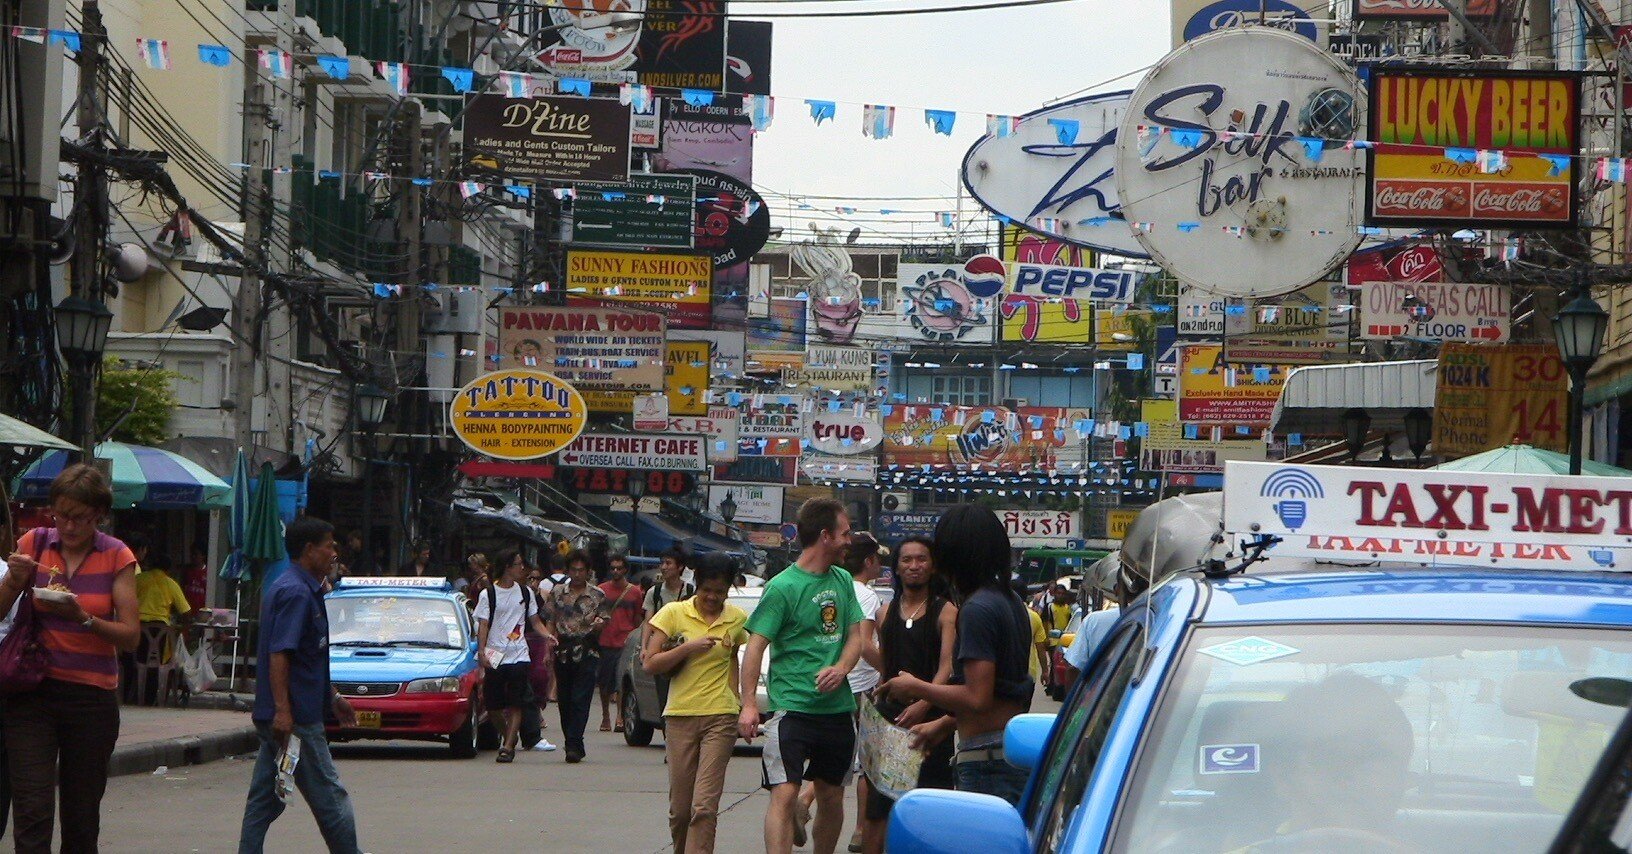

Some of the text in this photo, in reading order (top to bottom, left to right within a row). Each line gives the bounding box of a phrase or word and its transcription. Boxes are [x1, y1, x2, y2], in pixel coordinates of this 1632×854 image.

[1379, 77, 1572, 149] LUCKY BEER
[1144, 83, 1298, 172] Silk
[504, 140, 521, 149] and
[523, 140, 549, 150] Gents
[551, 141, 585, 152] Custom
[587, 143, 617, 154] Tailors
[1198, 157, 1272, 217] bar
[1376, 186, 1447, 210] Coca-Cola
[1473, 188, 1544, 213] Coca-Cola
[571, 256, 709, 277] SUNNY FASHIONS
[570, 274, 599, 284] LADIES
[602, 276, 609, 284] &
[611, 276, 637, 286] GENTS
[639, 278, 672, 287] CUSTOM
[1013, 265, 1133, 301] PEPSI
[1464, 284, 1508, 317] CALL
[503, 312, 601, 332] PAWANA
[604, 313, 661, 332] TOUR
[1416, 323, 1466, 338] FLOOR
[554, 335, 662, 346] WORLD WIDE AIR TICKETS
[625, 348, 660, 357] SERVICE
[840, 350, 870, 366] KUNG
[578, 371, 613, 380] SERVICE
[1513, 355, 1564, 382] 30
[466, 375, 571, 409] TATTOO
[1185, 389, 1221, 397] Exclusive
[1223, 389, 1243, 397] Hand
[463, 423, 573, 434] HENNA BODYPAINTING
[1511, 398, 1562, 442] 14
[752, 426, 800, 434] RESTAURANT
[812, 420, 865, 441] true
[480, 438, 501, 448] HAIR
[511, 438, 556, 448] EXTENSION
[654, 437, 698, 455] CAFE
[579, 455, 613, 466] OVERSEA
[356, 578, 428, 587] TAXI-METER
